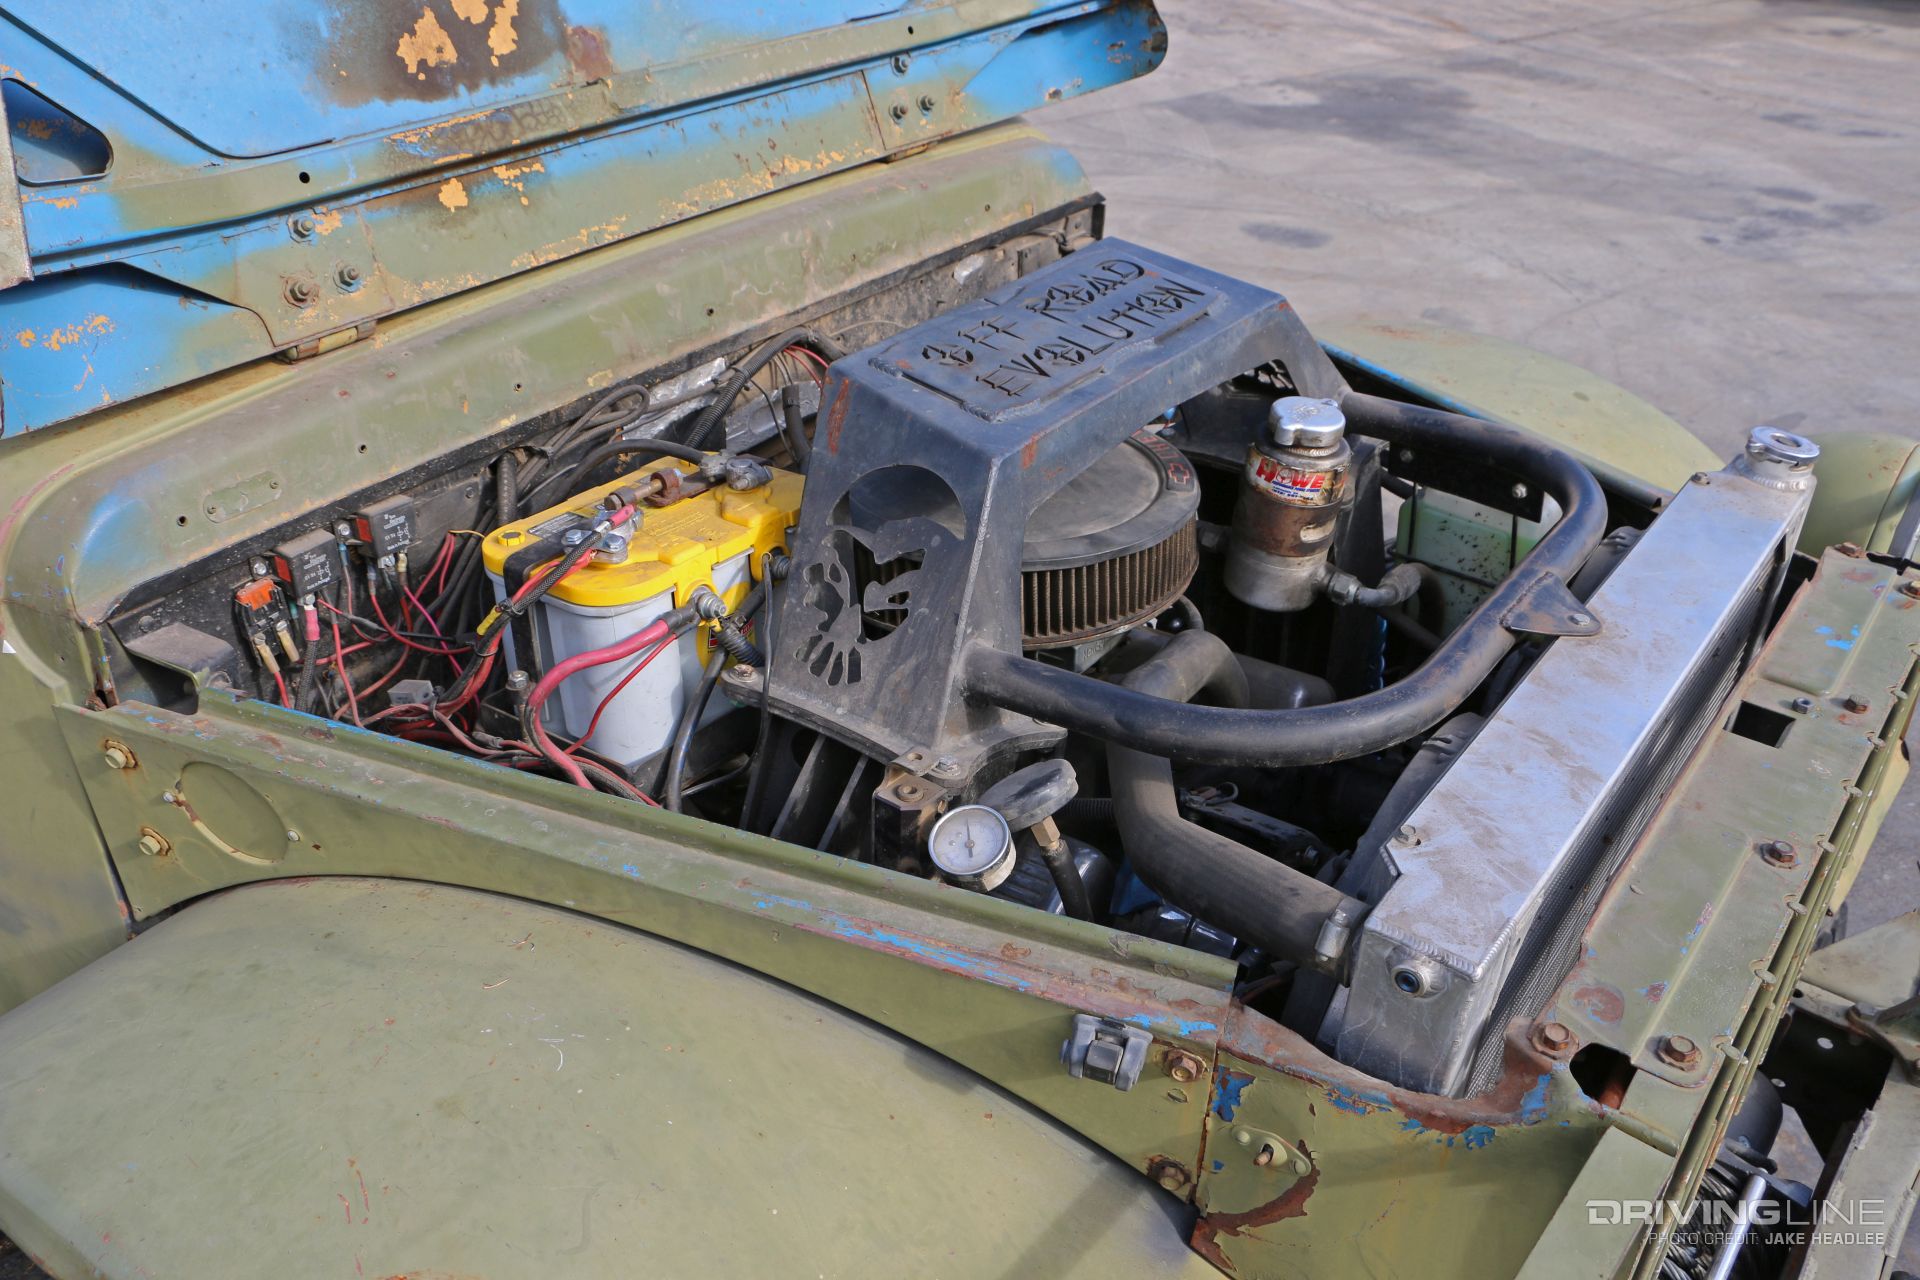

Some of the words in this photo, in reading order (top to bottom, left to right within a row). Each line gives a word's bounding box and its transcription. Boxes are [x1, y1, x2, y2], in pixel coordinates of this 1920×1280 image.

[921, 315, 1025, 366] OFF
[1025, 259, 1145, 323] ROAD
[975, 277, 1206, 397] EVOLUTION
